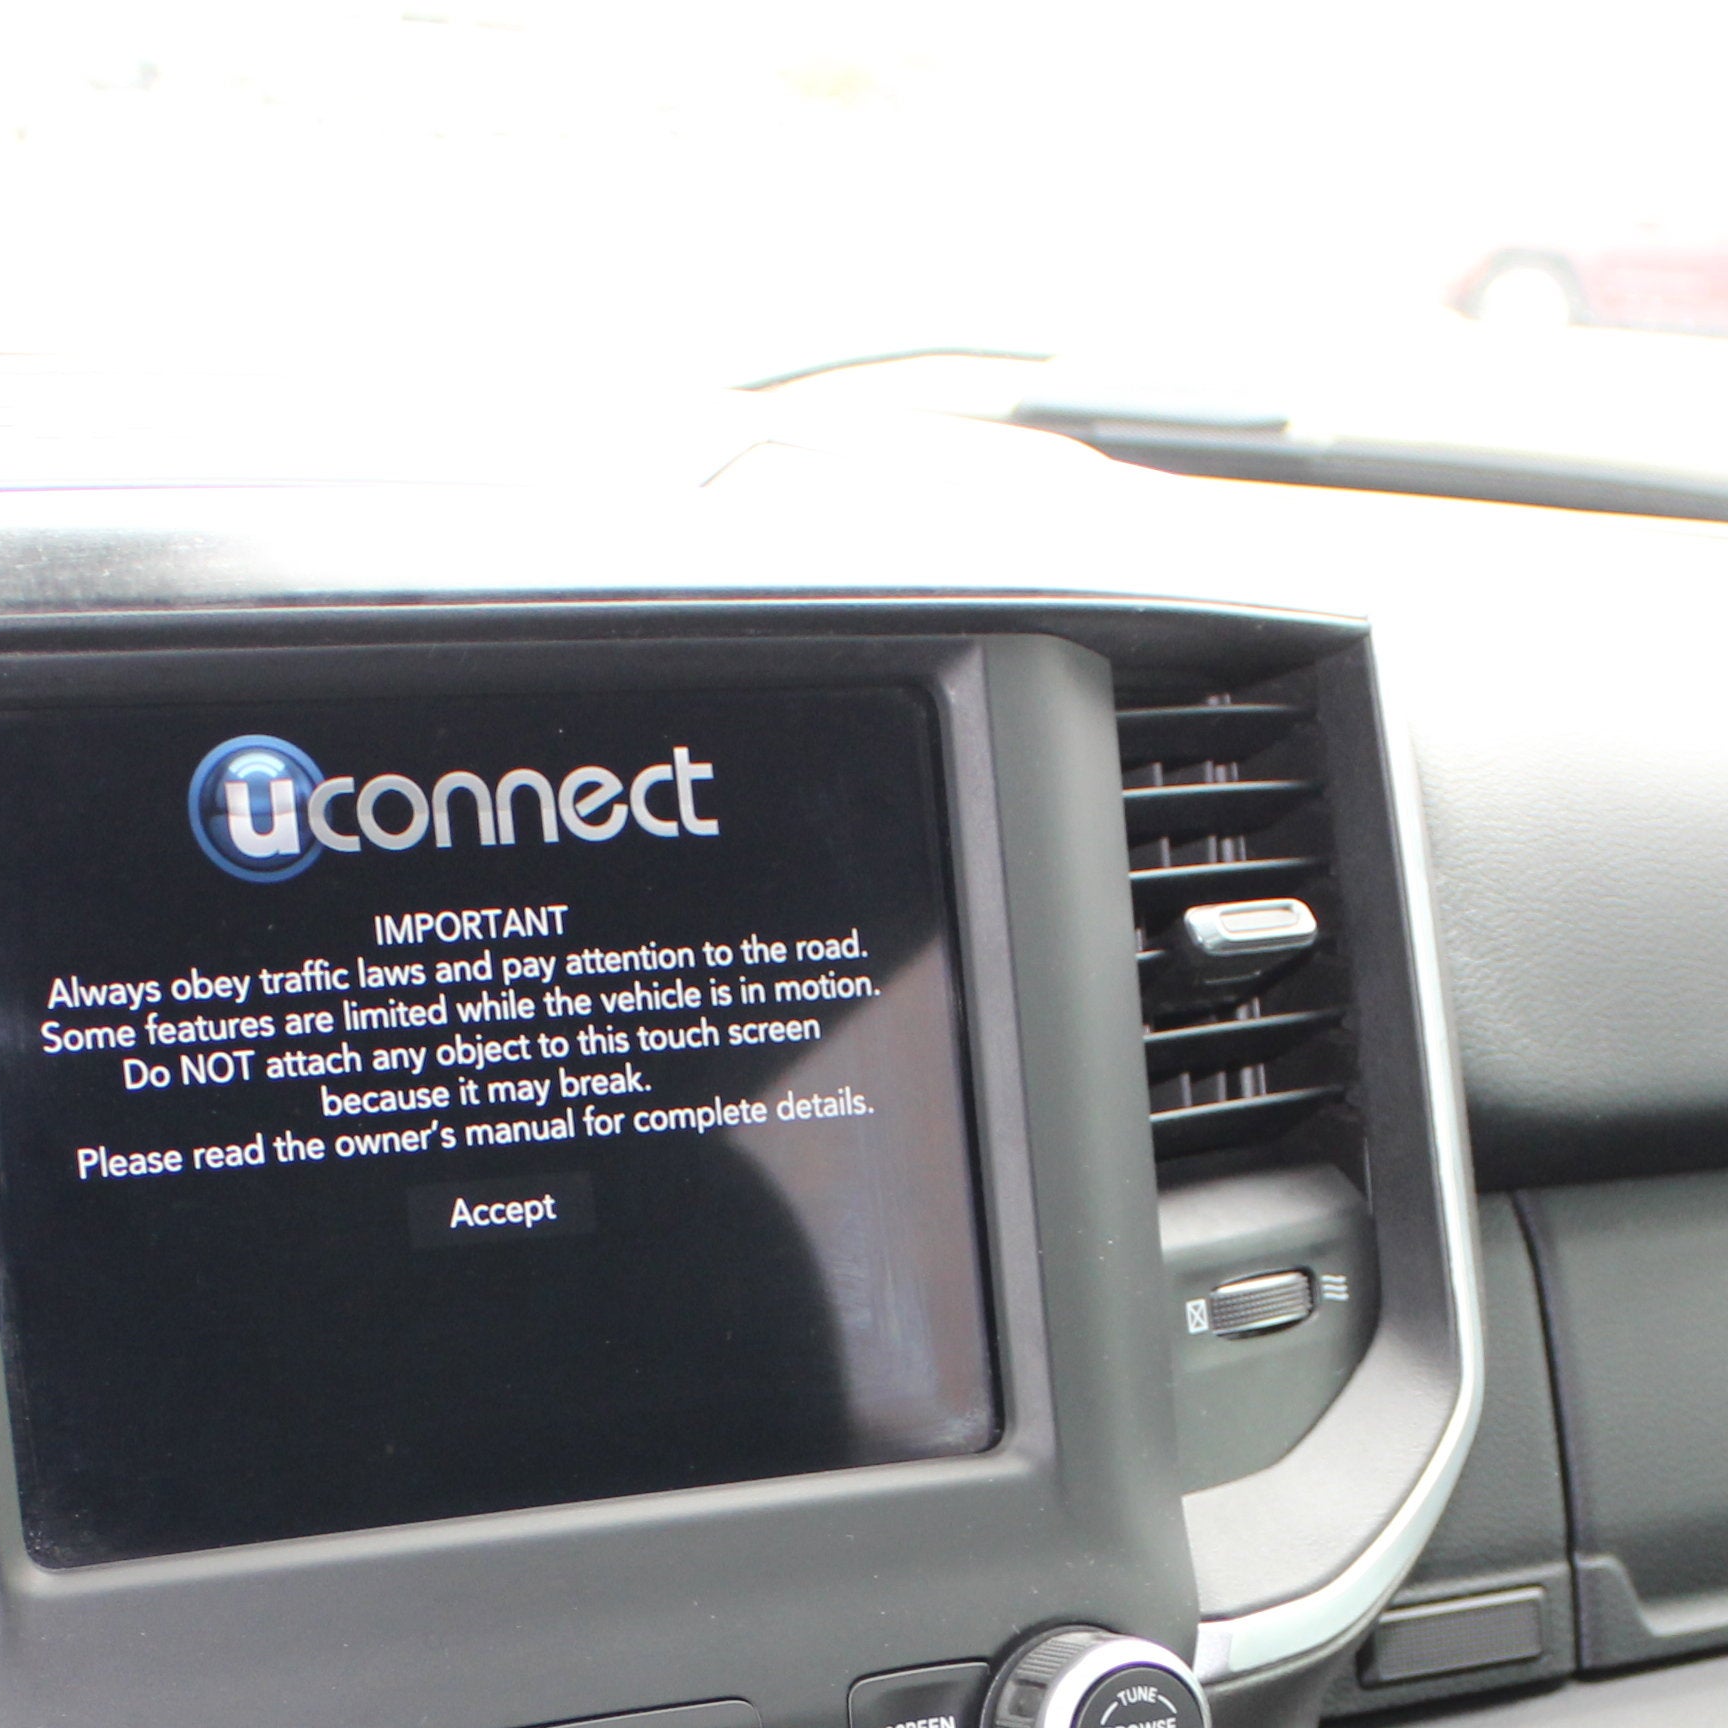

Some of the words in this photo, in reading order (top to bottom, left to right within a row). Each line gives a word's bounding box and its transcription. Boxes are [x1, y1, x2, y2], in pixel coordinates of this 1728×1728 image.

[374, 904, 569, 946] IMPORTANT
[47, 975, 162, 1010] Always
[171, 967, 251, 1003] obey
[258, 958, 350, 996] traffic
[357, 956, 426, 989] laws
[435, 949, 493, 983] and
[501, 956, 557, 984] pay
[565, 941, 696, 977] attention
[702, 940, 734, 967] to
[740, 932, 788, 965] the
[795, 927, 869, 961] road.
[40, 1021, 137, 1054] Some
[144, 1012, 276, 1047] features
[284, 1008, 335, 1036] are
[342, 992, 448, 1032] limited
[455, 988, 536, 1025] while
[543, 985, 593, 1018] the
[599, 978, 702, 1015] vehicle
[709, 976, 734, 1008] is
[738, 975, 767, 1005] in
[774, 970, 882, 1002] motion.
[122, 1057, 172, 1092] Do
[179, 1049, 257, 1086] NOT
[265, 1041, 363, 1079] attach
[371, 1044, 427, 1075] any
[435, 1034, 532, 1070] object
[537, 1031, 571, 1059] to
[576, 1023, 631, 1056] this
[636, 1015, 721, 1052] touch
[727, 1016, 822, 1047] screen
[320, 1081, 451, 1118] because
[458, 1075, 482, 1106] it
[487, 1076, 551, 1106] may
[558, 1061, 652, 1099] break.
[76, 1145, 184, 1180] Please
[192, 1132, 266, 1170] read
[273, 1129, 326, 1163] the
[465, 1106, 576, 1148] manual
[582, 1104, 626, 1138] for
[632, 1095, 768, 1135] complete
[775, 1085, 875, 1122] details.
[449, 1193, 558, 1229] Accept
[1116, 1685, 1159, 1707] TUNE
